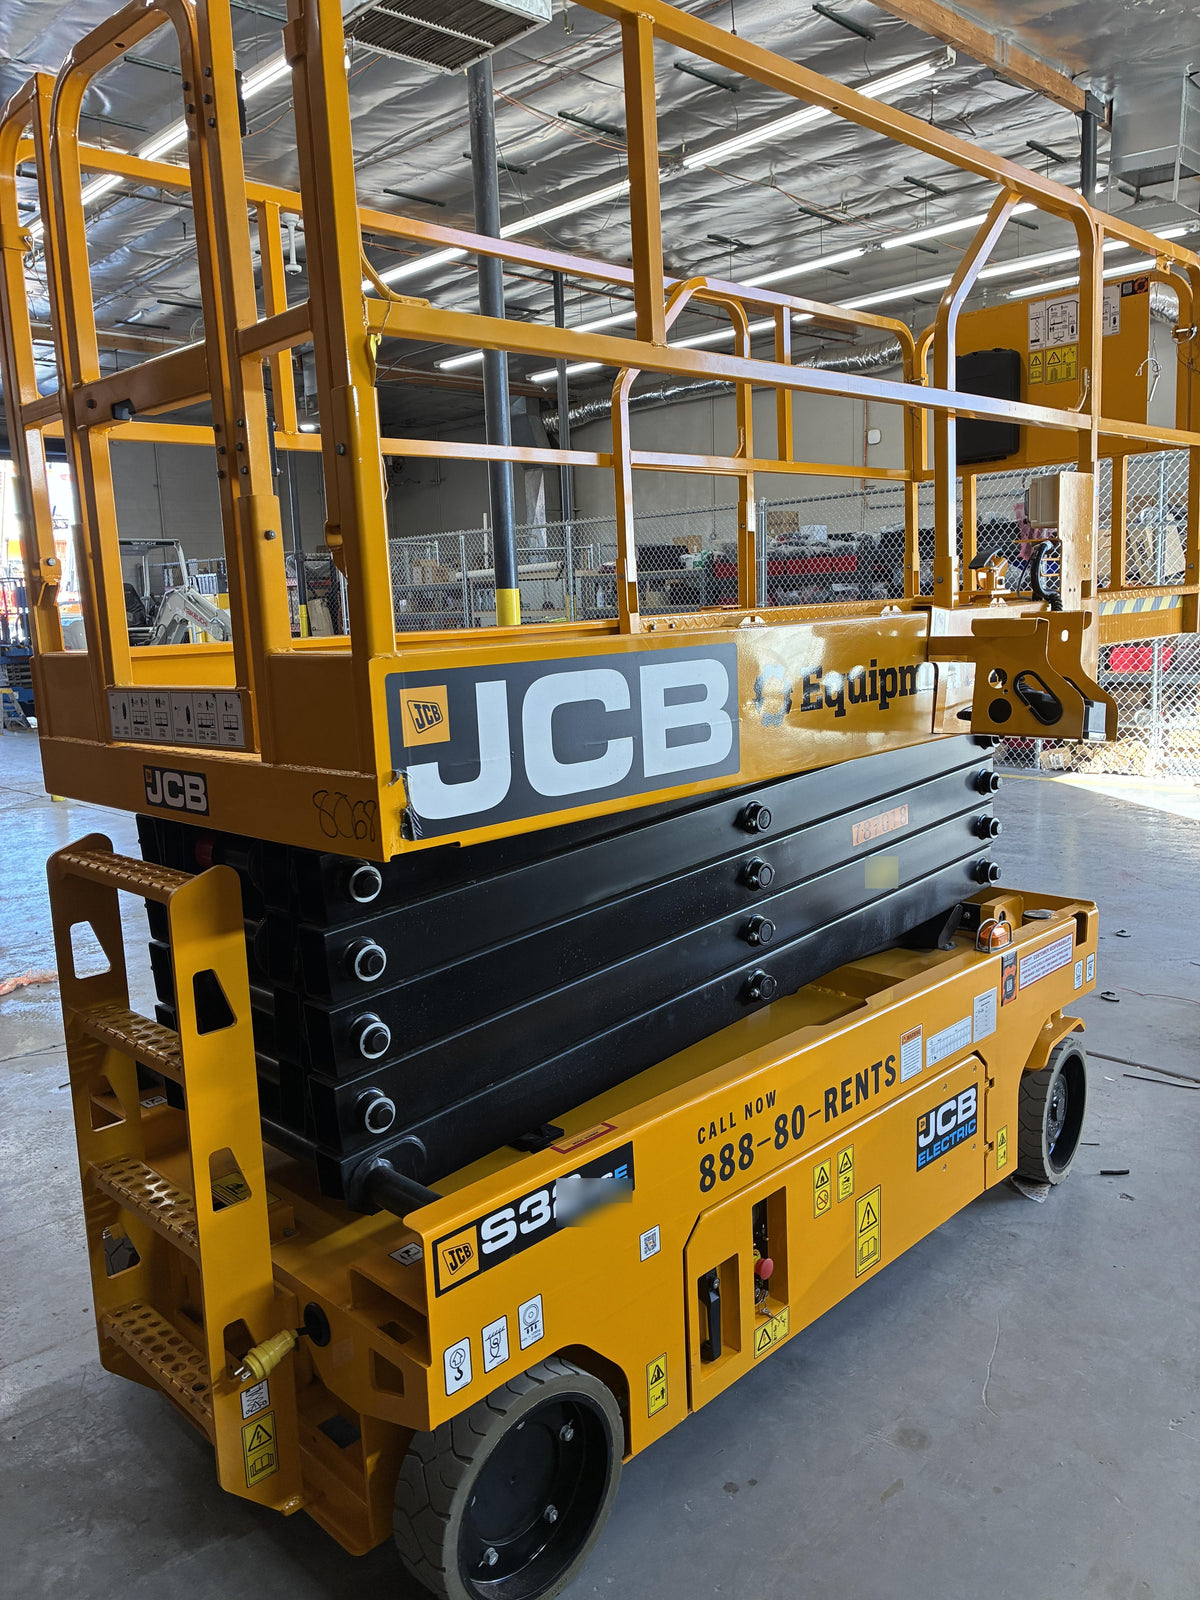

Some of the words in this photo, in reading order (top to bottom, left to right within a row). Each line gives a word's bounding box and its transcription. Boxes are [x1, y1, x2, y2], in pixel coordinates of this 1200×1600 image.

[407, 658, 734, 820] JCB
[413, 704, 441, 730] JCB
[146, 769, 208, 814] JCB
[697, 1113, 737, 1145] CALL
[744, 1090, 777, 1121] NOW
[699, 1054, 897, 1193] 888-80-RENTS
[918, 1086, 977, 1147] JCB
[918, 1118, 977, 1168] ELECTRIC
[447, 1244, 472, 1272] JCB
